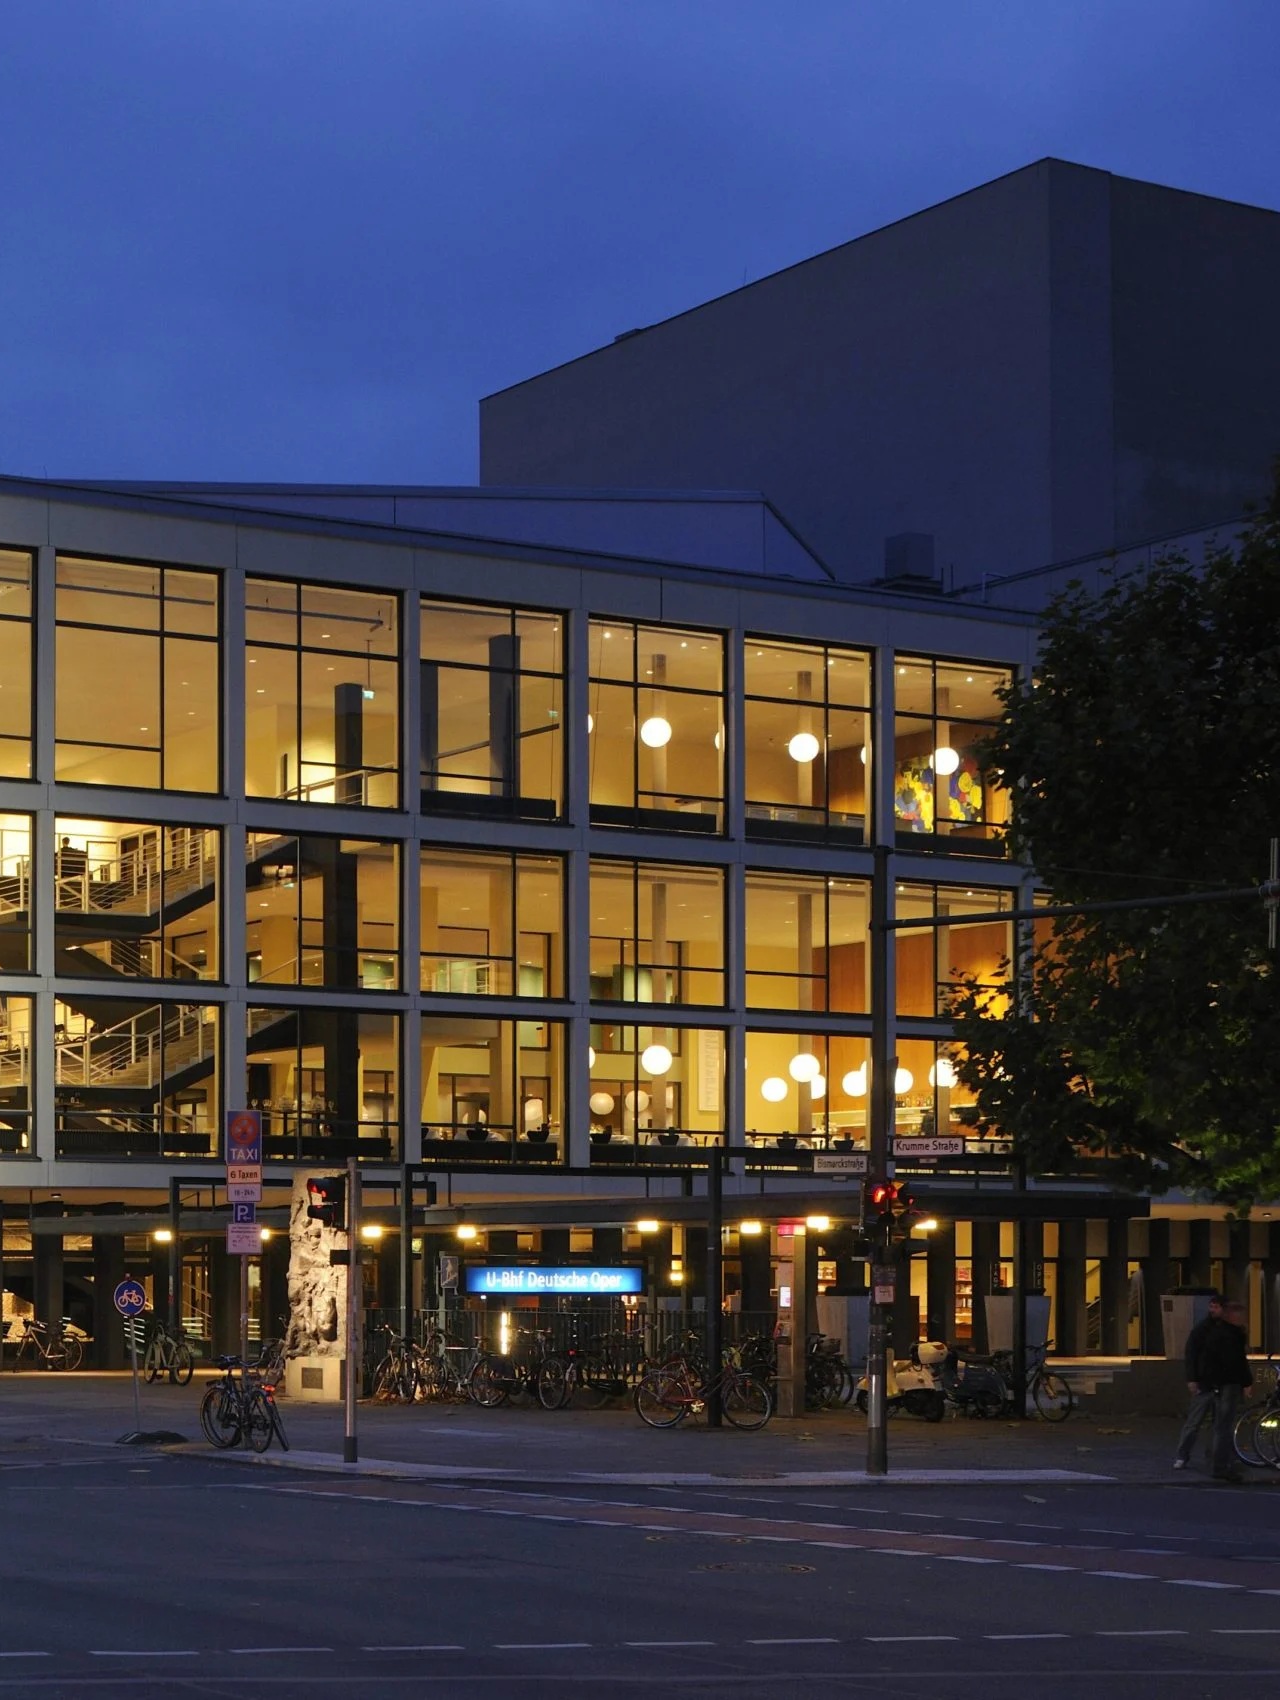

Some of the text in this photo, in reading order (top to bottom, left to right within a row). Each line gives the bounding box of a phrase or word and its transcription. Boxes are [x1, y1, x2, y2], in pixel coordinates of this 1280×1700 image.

[896, 1140, 959, 1152] Krumme Straße
[230, 1148, 258, 1160] TAXI
[817, 1157, 865, 1170] Bismarckstraße
[230, 1170, 258, 1179] 6 Taxen
[237, 1205, 249, 1222] P
[486, 1271, 622, 1292] U-Bhf Deutsche Oper
